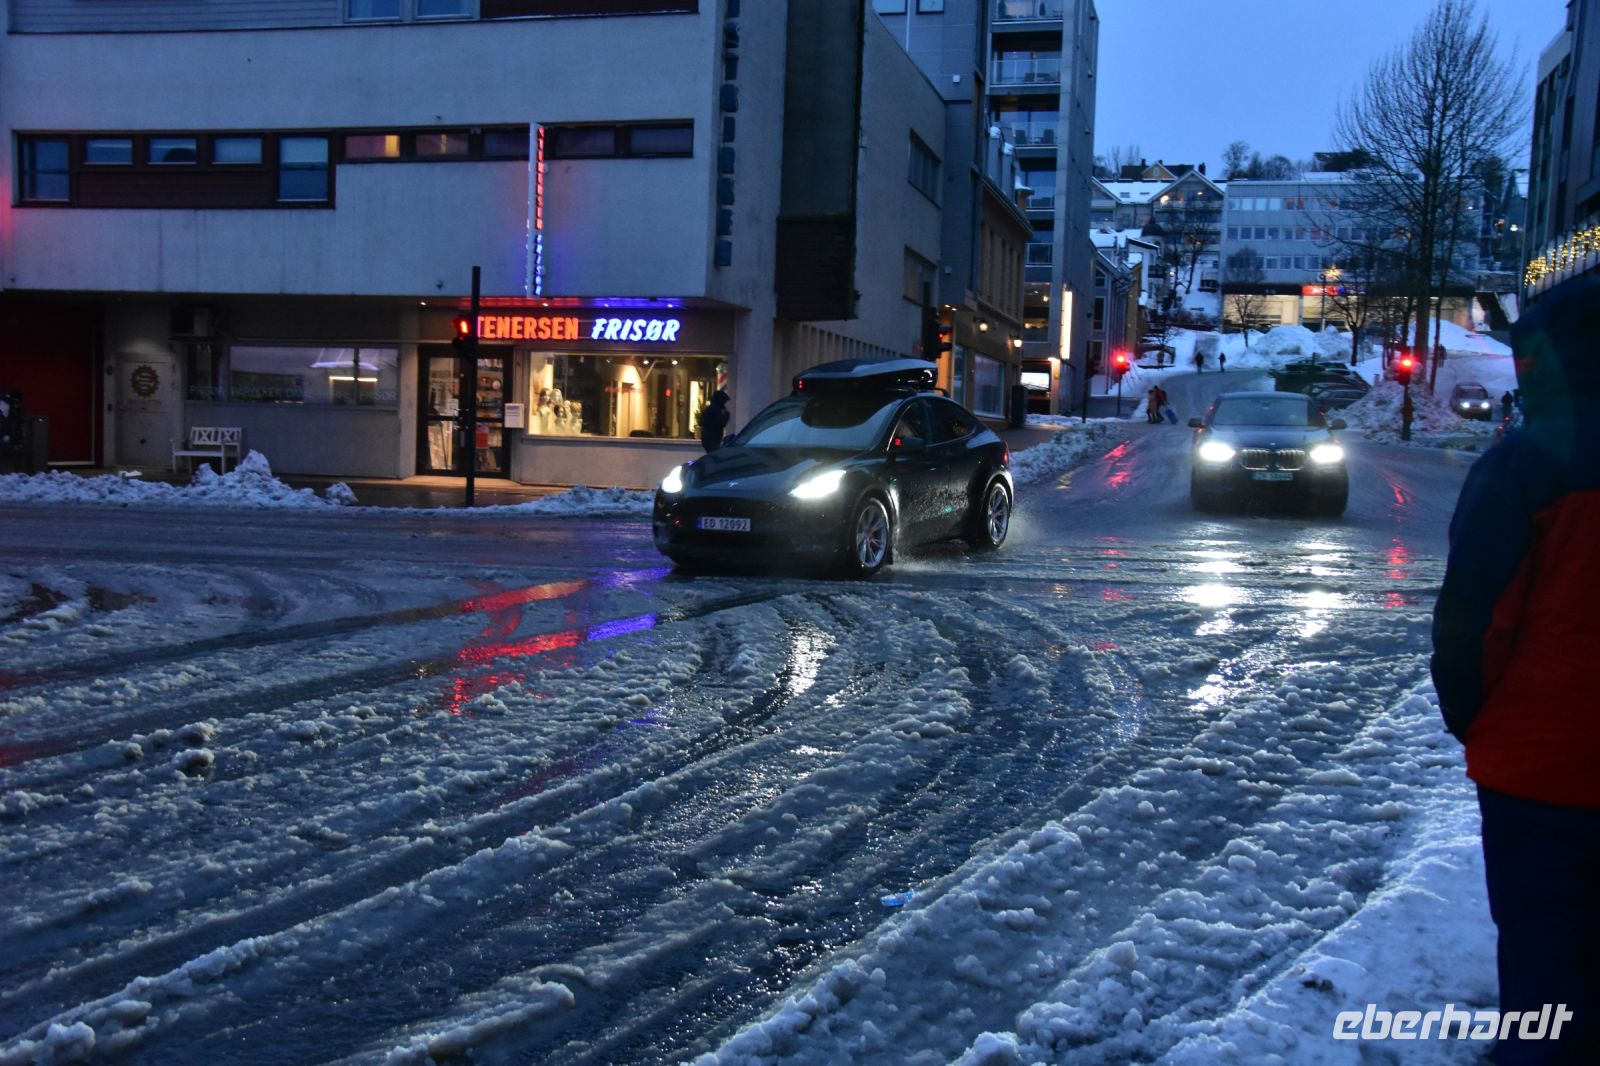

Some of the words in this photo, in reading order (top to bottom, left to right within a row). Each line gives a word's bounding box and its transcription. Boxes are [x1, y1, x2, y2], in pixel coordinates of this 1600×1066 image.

[477, 315, 579, 340] TENERSEN
[591, 317, 681, 341] FRISØR
[719, 519, 748, 529] 12092
